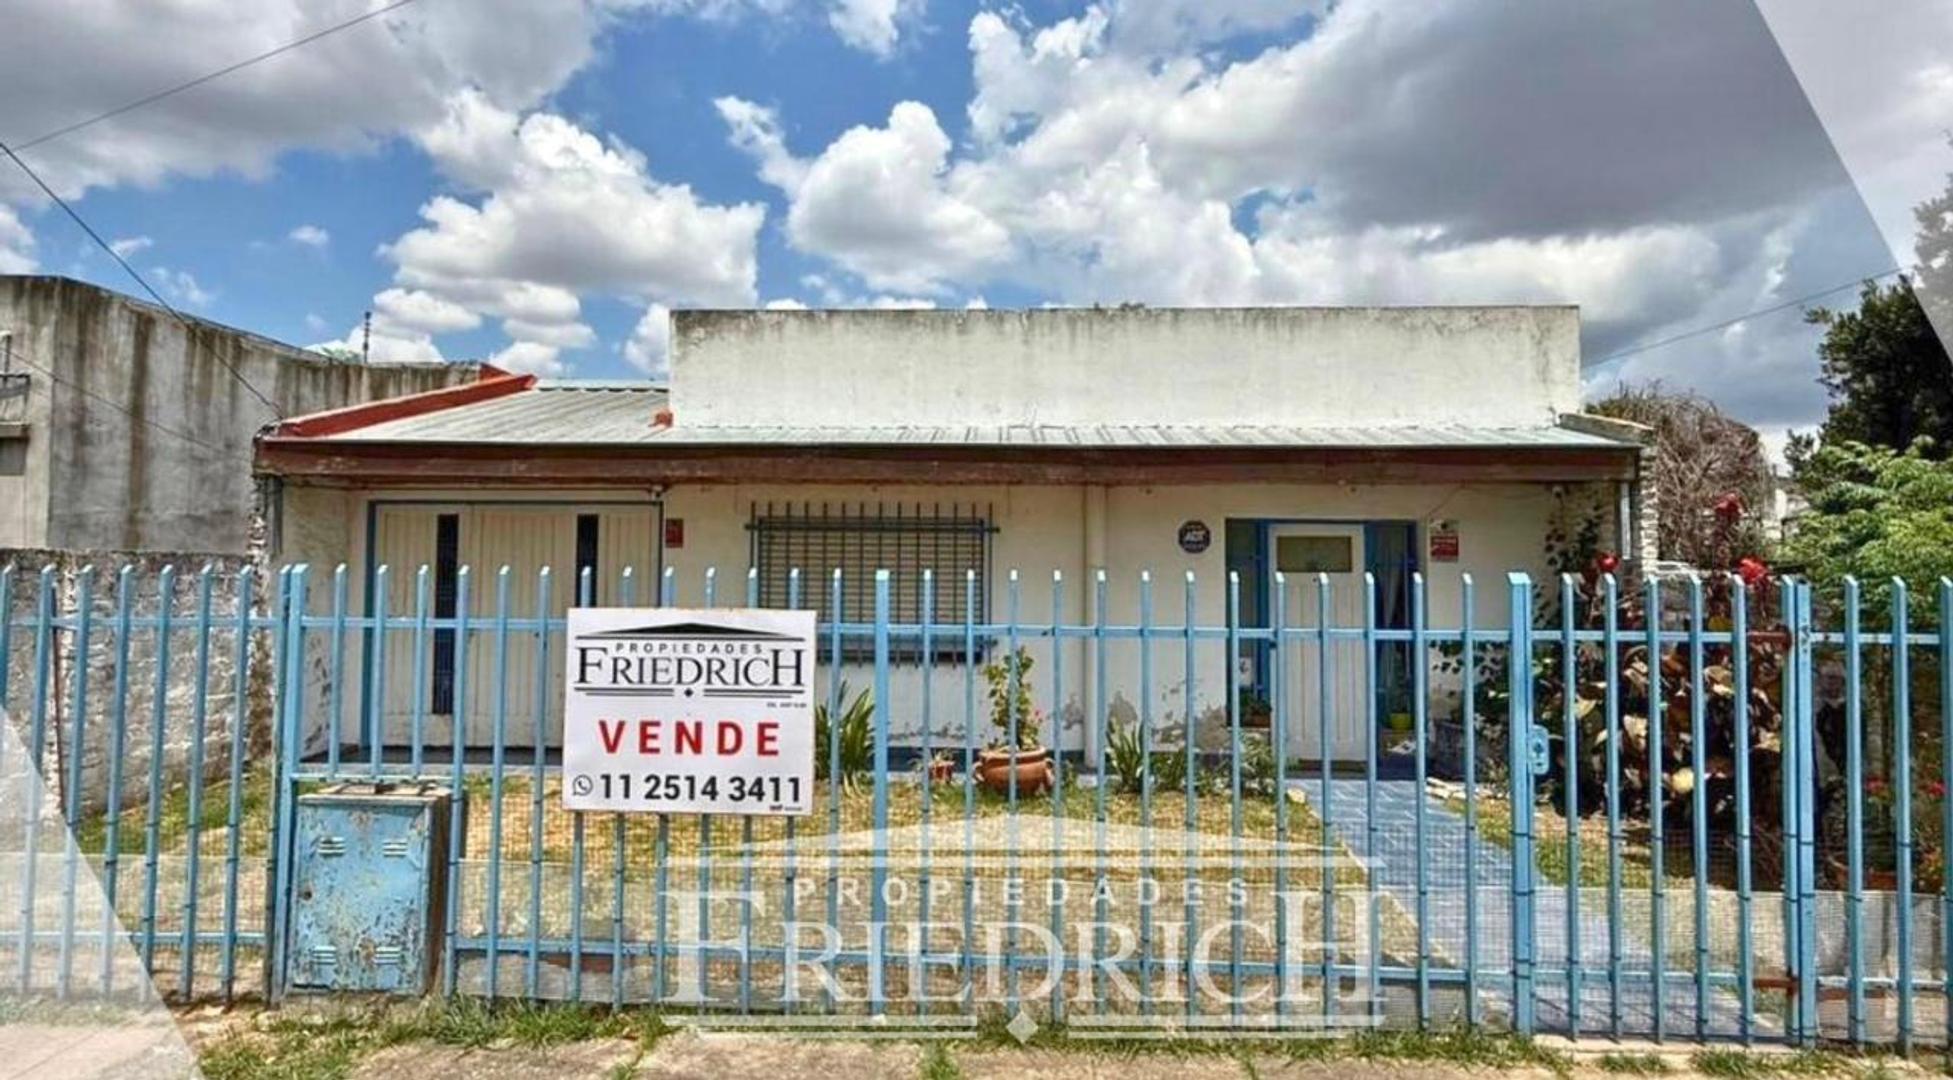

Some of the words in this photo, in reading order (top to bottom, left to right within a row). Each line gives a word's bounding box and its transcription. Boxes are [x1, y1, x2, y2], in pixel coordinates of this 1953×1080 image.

[615, 642, 763, 655] PROPIEDADES
[574, 646, 806, 687] FRIEDRICH
[598, 720, 779, 756] VENDE
[600, 774, 631, 799] 11
[643, 774, 719, 801] 2514
[728, 776, 800, 803] 3411
